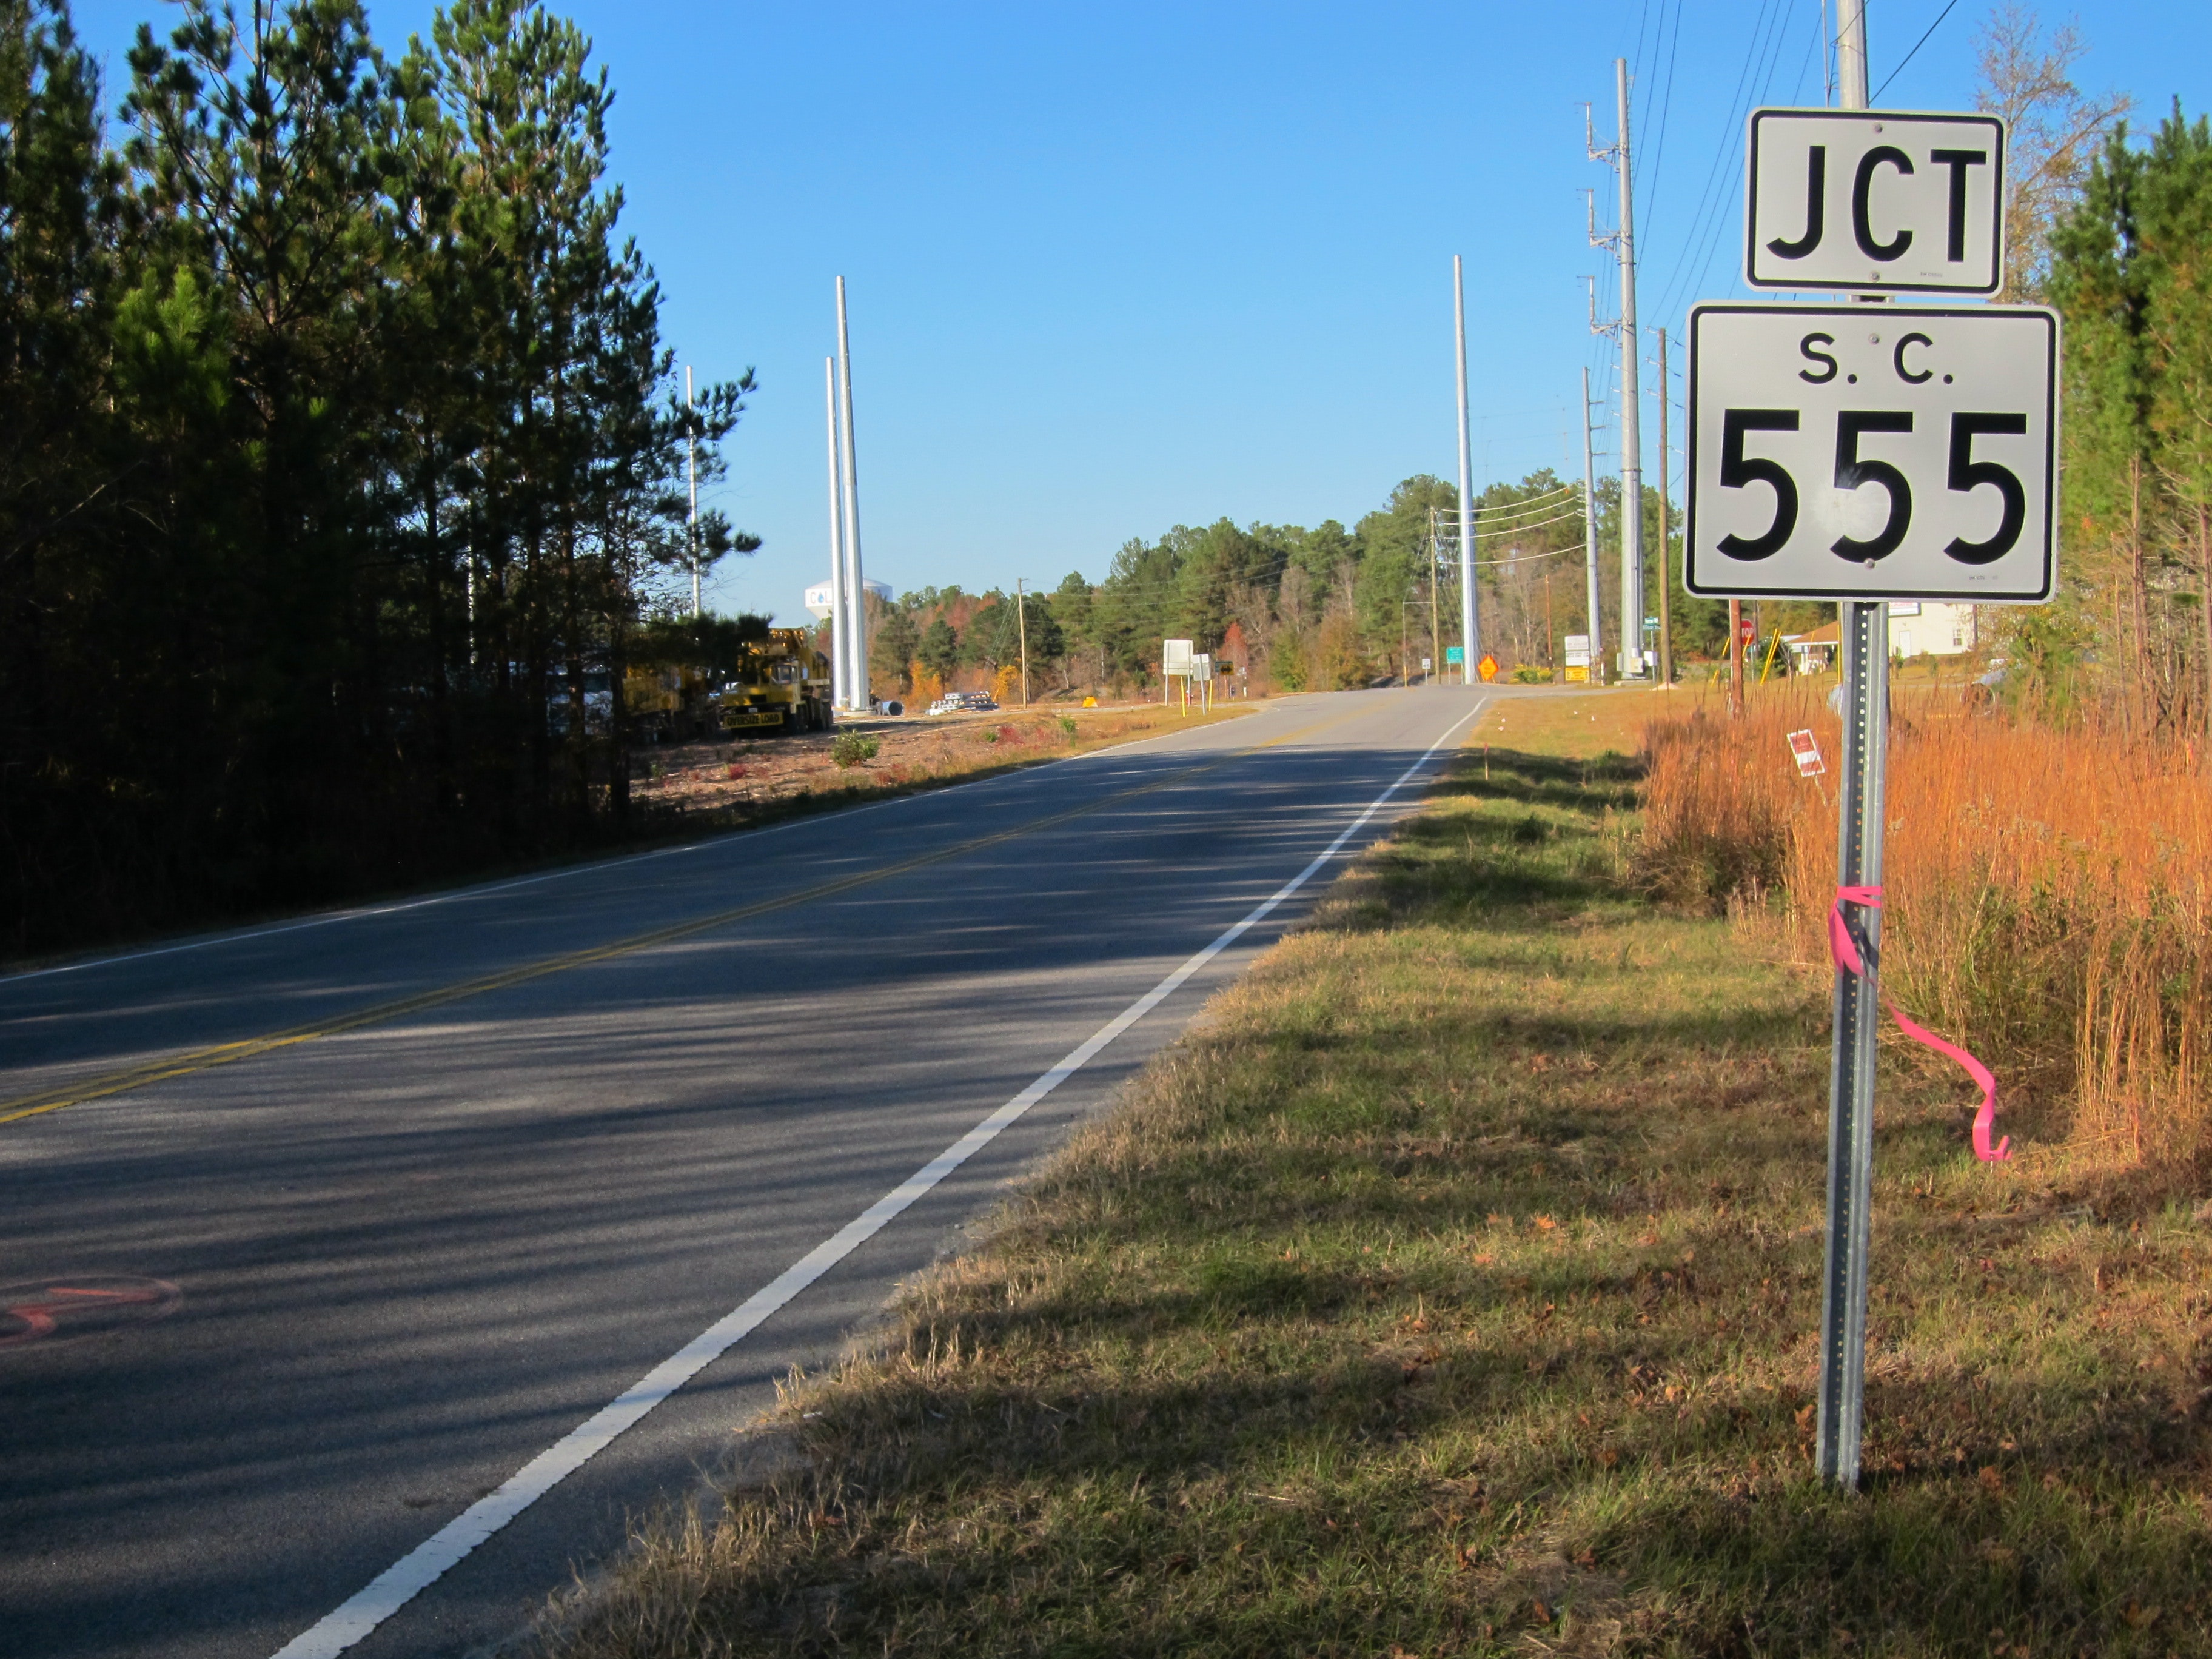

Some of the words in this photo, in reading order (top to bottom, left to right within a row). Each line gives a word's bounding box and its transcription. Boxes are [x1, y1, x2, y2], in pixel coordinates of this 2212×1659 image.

[1767, 145, 1986, 262] JCT
[1798, 332, 1857, 384] S.
[1893, 332, 1954, 384] C.
[1716, 409, 2027, 565] 555
[1741, 628, 1754, 638] TOP
[727, 715, 759, 726] OVERSIZE
[761, 714, 780, 725] LOAD
